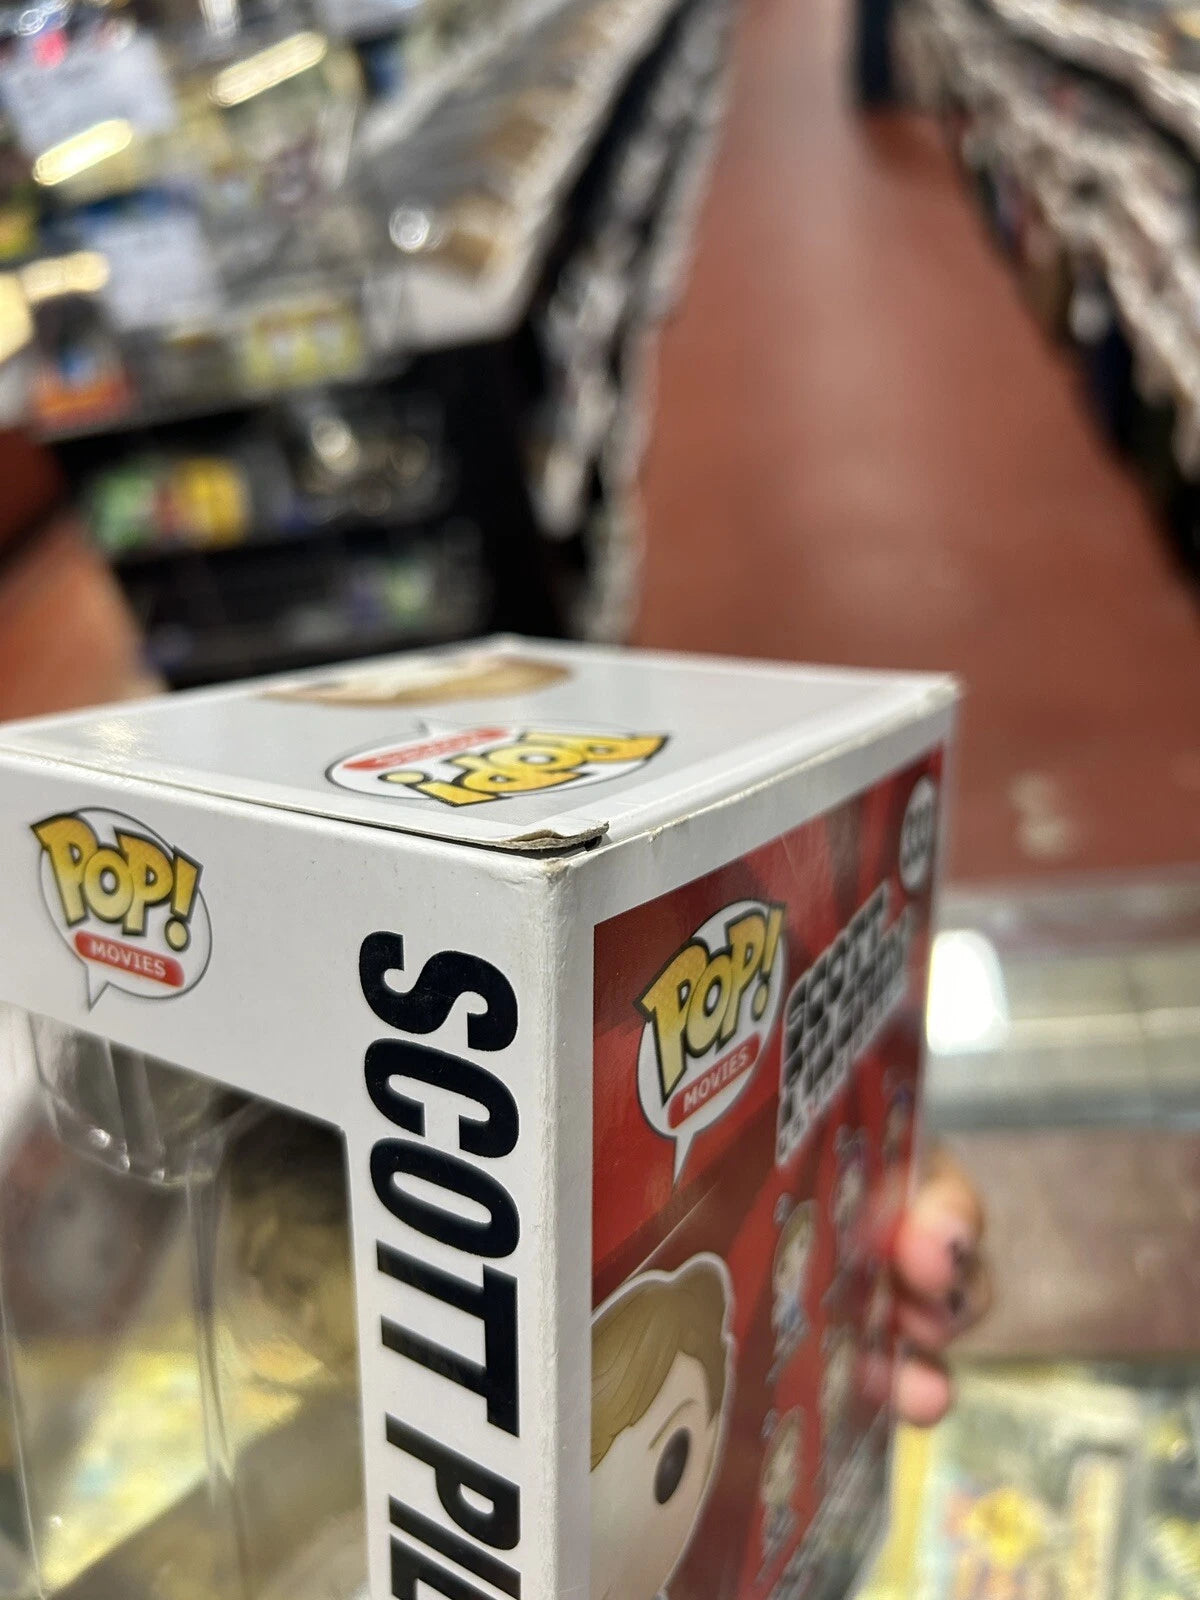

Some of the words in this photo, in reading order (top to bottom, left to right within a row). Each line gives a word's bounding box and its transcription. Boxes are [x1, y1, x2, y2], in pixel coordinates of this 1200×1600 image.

[377, 734, 668, 806] POP!
[31, 813, 203, 951] POP!
[90, 942, 166, 975] MOVIES
[633, 904, 784, 1106] POP!
[683, 1047, 748, 1114] MOVIES
[360, 931, 519, 1438] SCOTT
